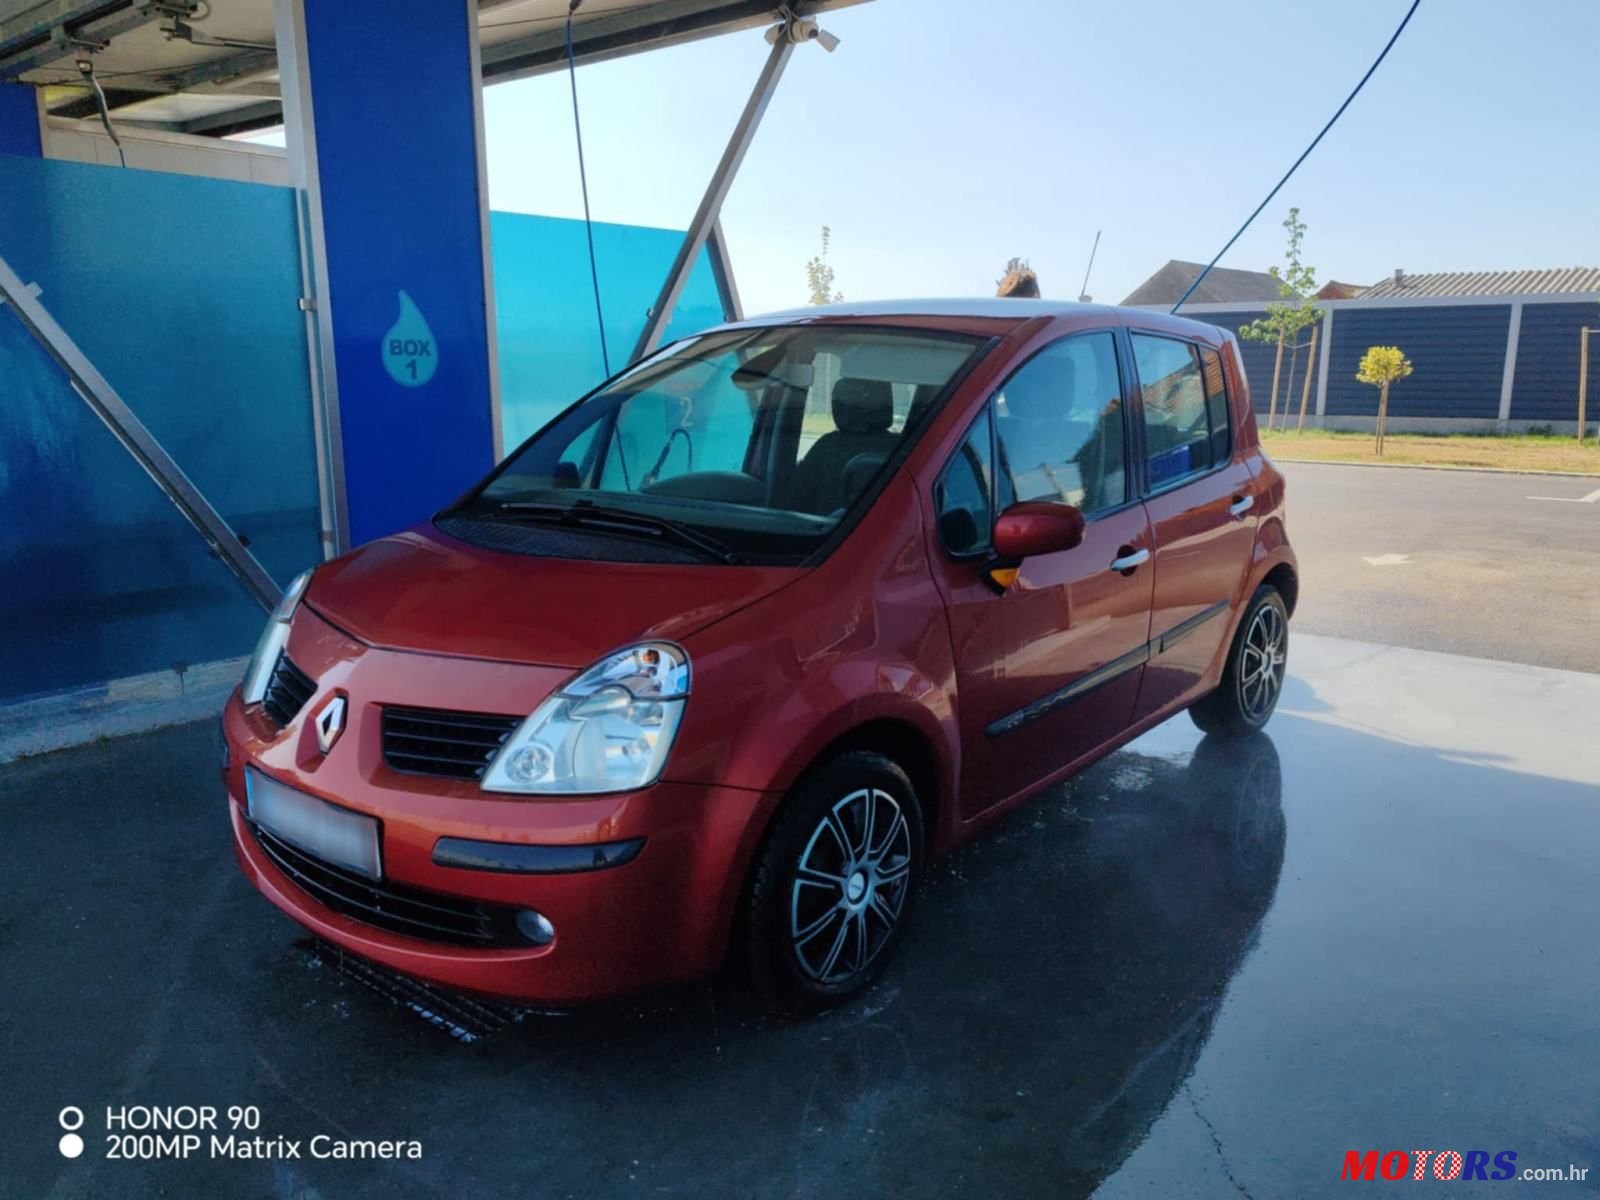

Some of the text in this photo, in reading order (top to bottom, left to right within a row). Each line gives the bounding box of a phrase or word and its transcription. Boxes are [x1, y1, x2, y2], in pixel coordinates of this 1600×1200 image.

[389, 339, 432, 356] BOX
[406, 359, 417, 380] 1
[679, 396, 694, 428] 2
